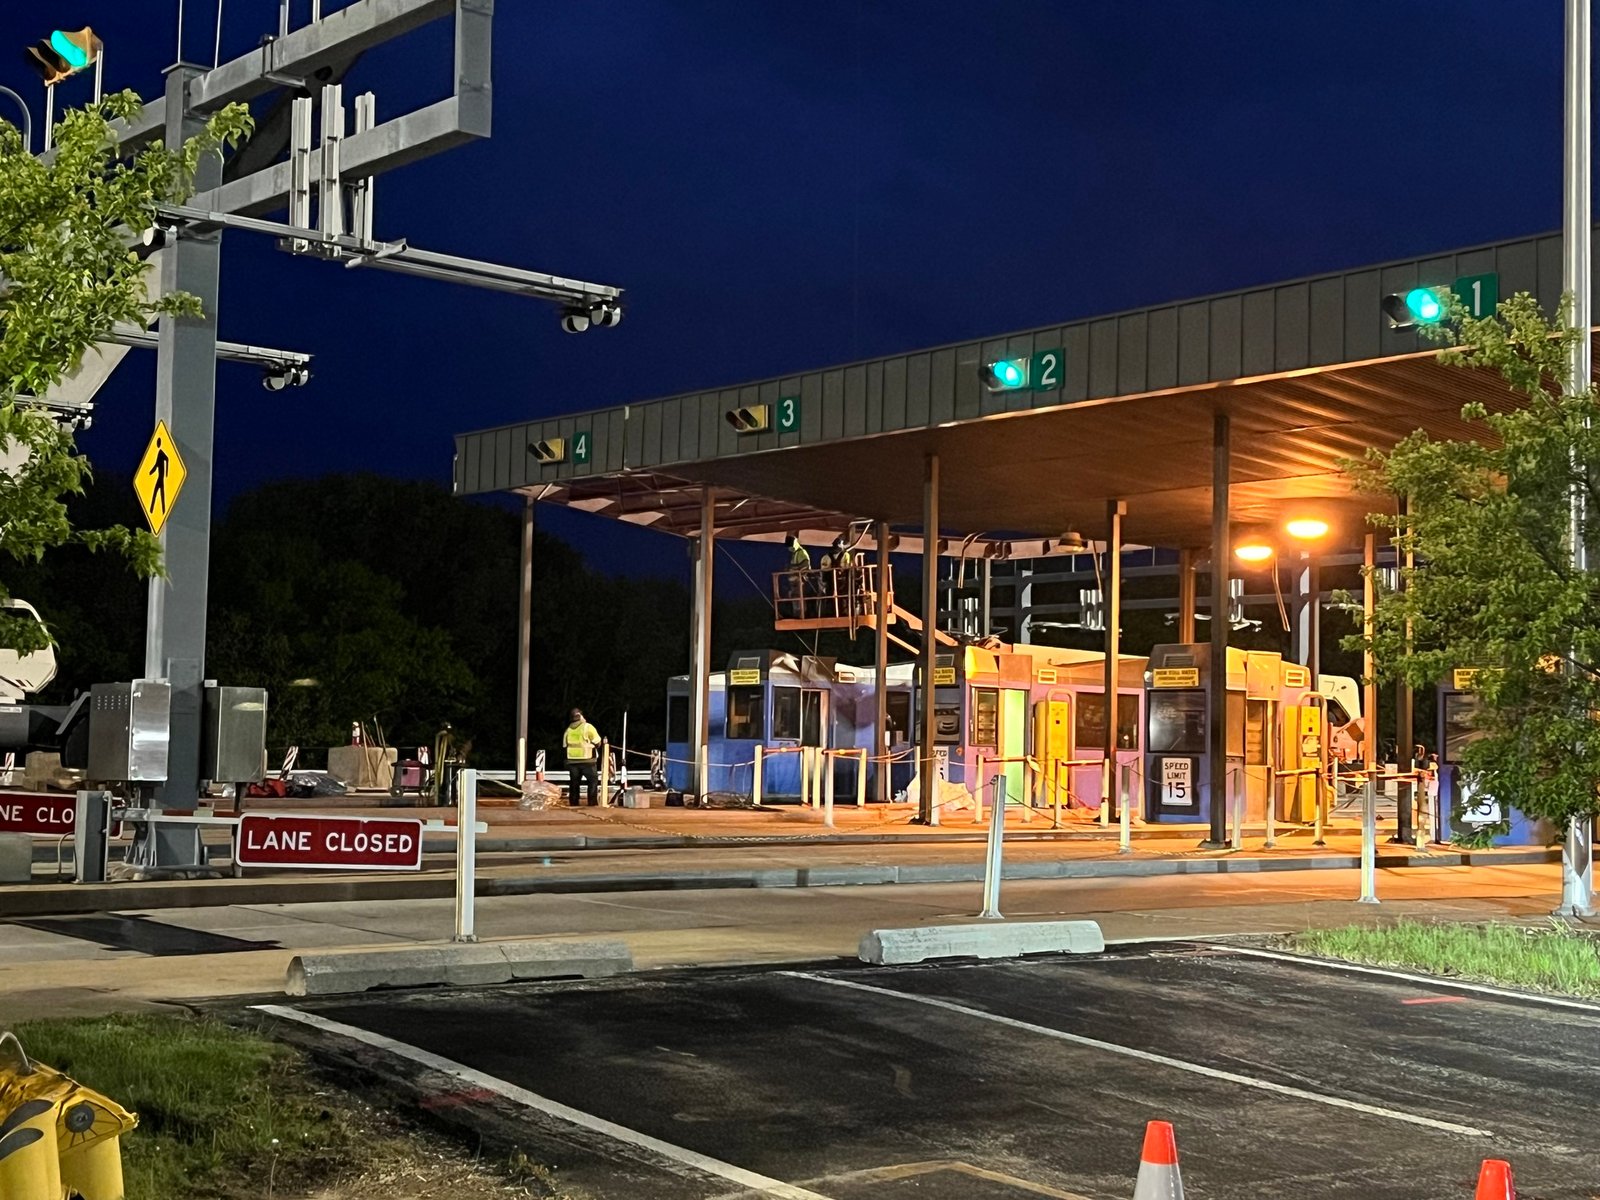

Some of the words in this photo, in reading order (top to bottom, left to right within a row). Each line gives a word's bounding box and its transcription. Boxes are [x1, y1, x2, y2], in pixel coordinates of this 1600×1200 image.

[1471, 280, 1481, 317] 1
[1041, 353, 1057, 385] 2
[781, 399, 794, 427] 3
[575, 435, 586, 459] 4
[1164, 762, 1189, 770] SPEED
[1166, 771, 1186, 780] LIMIT
[1167, 781, 1186, 799] 15
[247, 830, 312, 851] LANE
[325, 832, 413, 853] CLOSED
